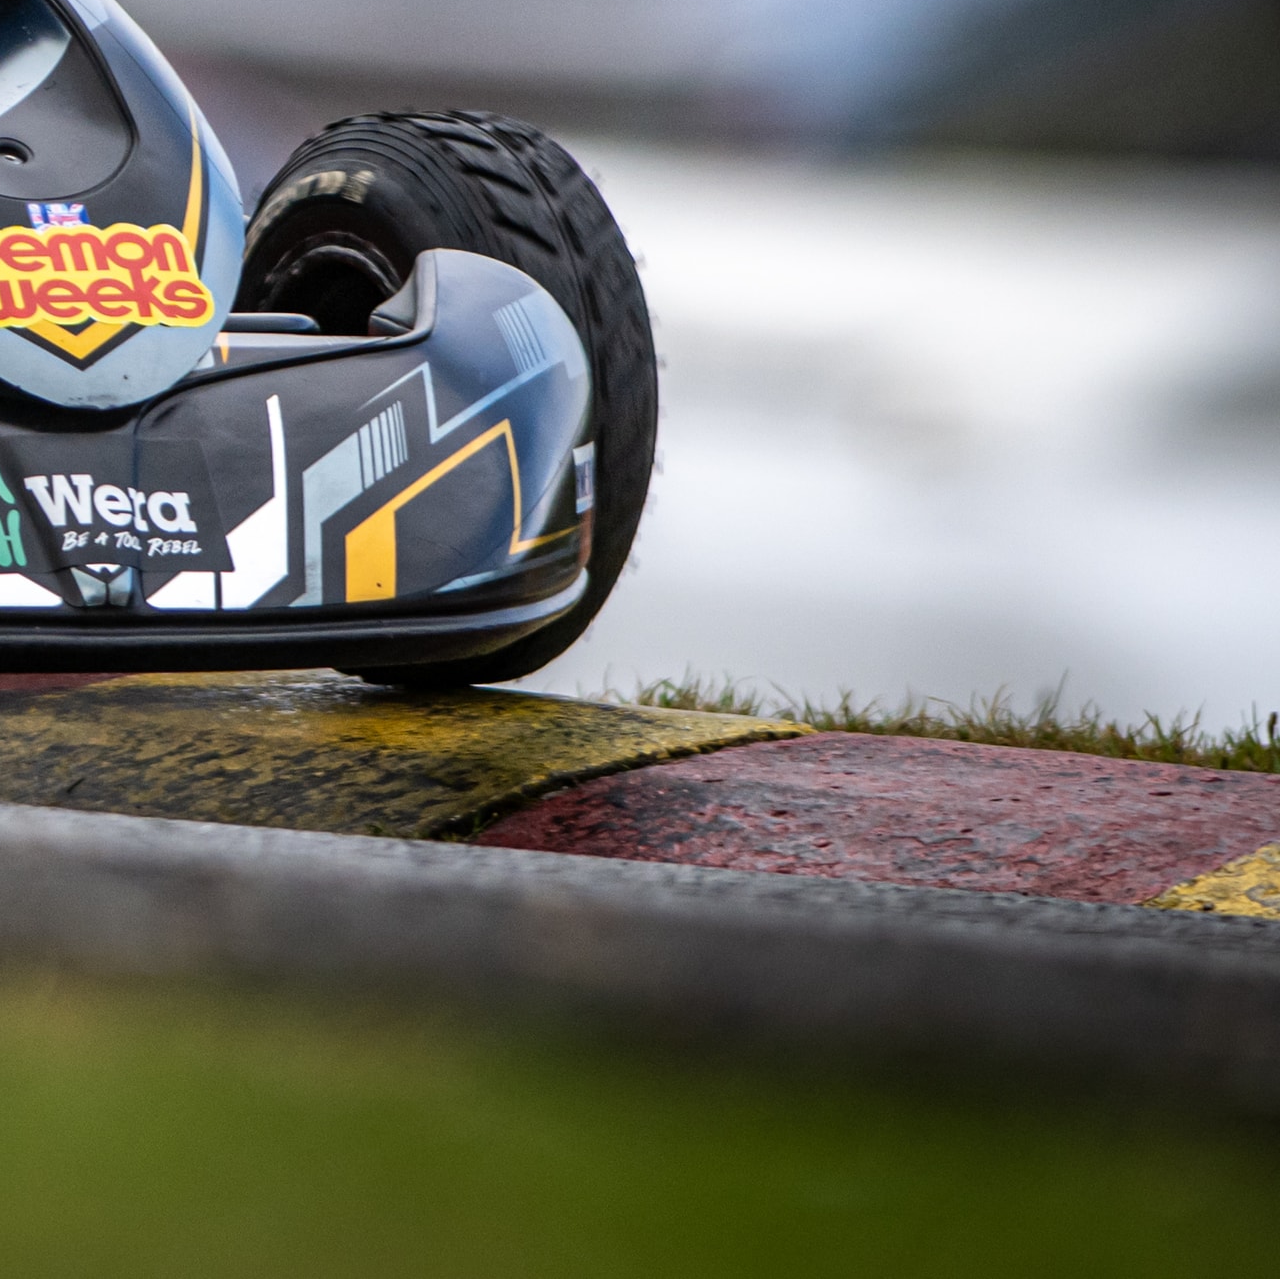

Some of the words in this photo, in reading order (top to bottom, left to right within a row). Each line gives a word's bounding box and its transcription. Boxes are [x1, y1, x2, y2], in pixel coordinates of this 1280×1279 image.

[23, 474, 198, 533] Wera
[61, 530, 90, 552] BE
[94, 532, 108, 546] A
[147, 537, 203, 556] REBEL
